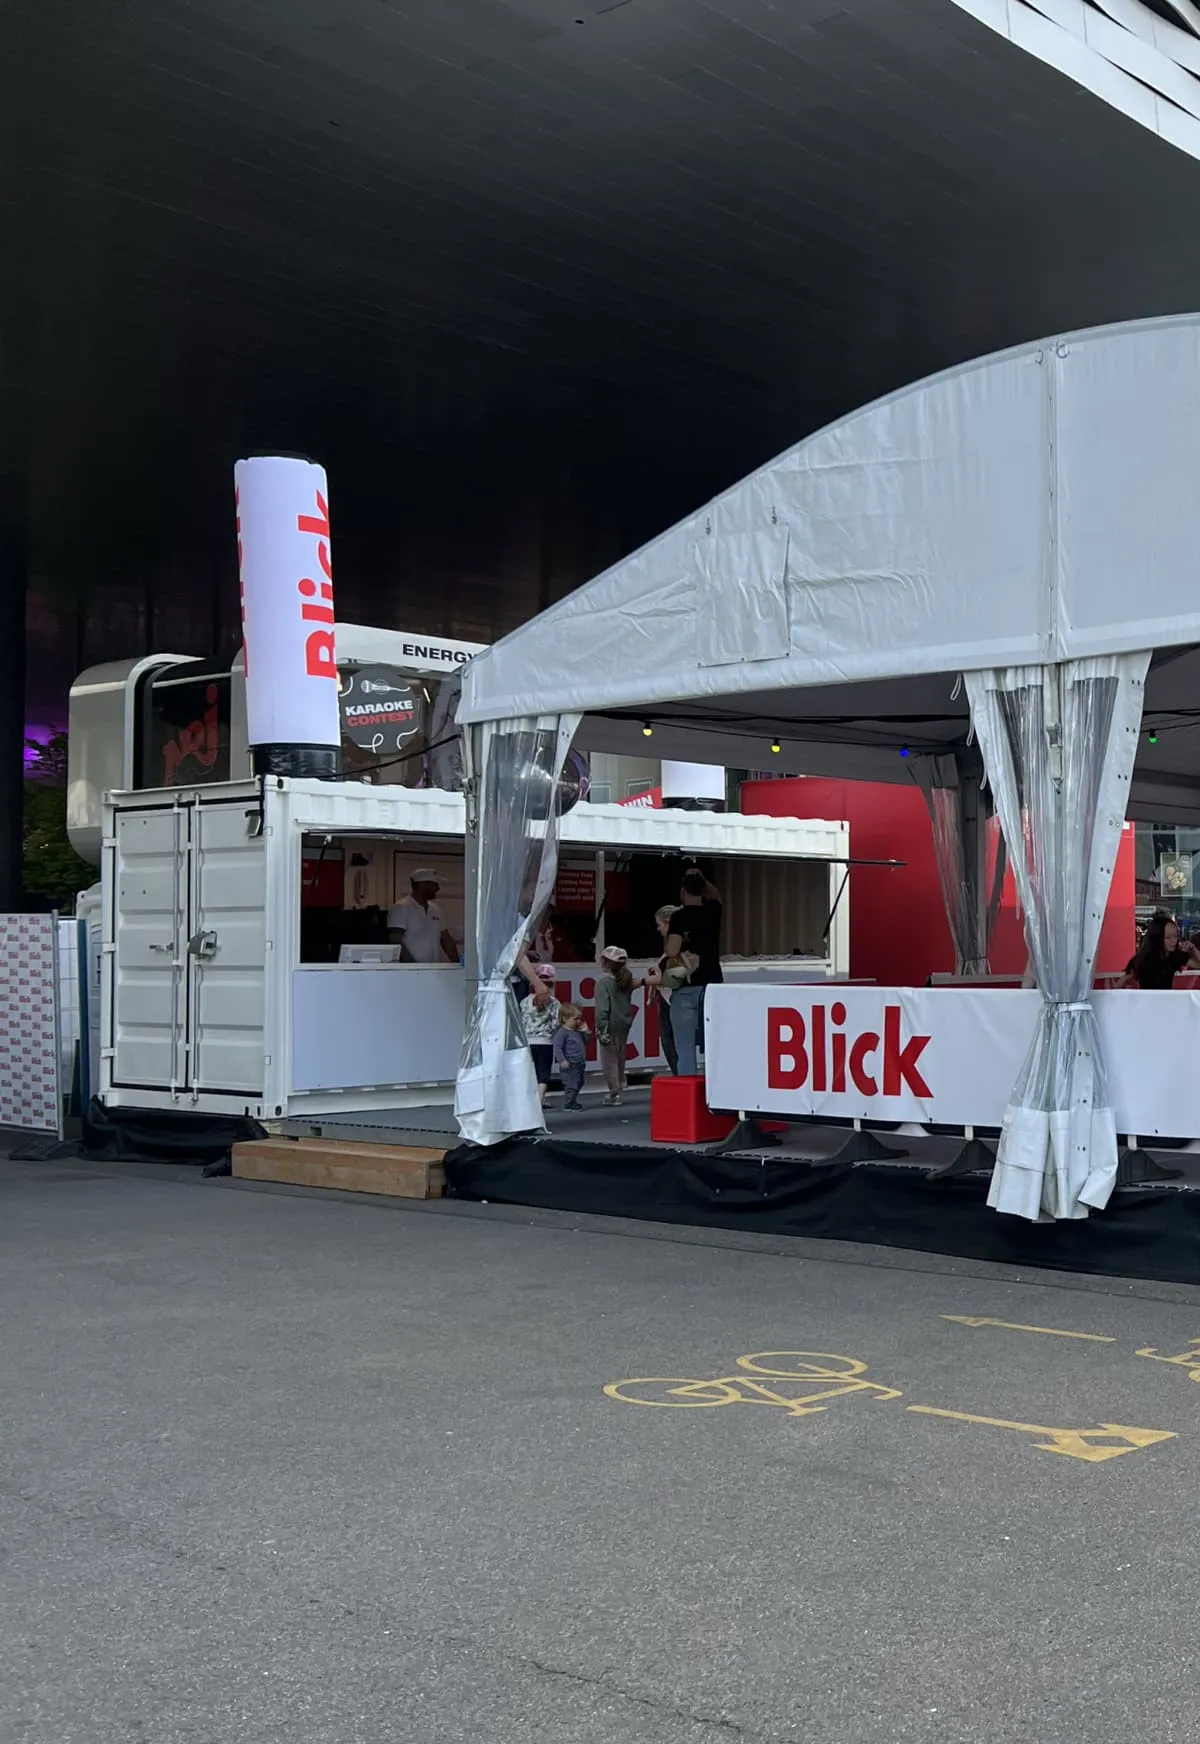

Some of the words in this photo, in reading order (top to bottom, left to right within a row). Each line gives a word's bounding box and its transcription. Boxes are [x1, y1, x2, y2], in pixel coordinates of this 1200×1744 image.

[345, 700, 414, 716] KARAOKE
[347, 711, 415, 727] CONTEST
[768, 1003, 931, 1098] Blick
